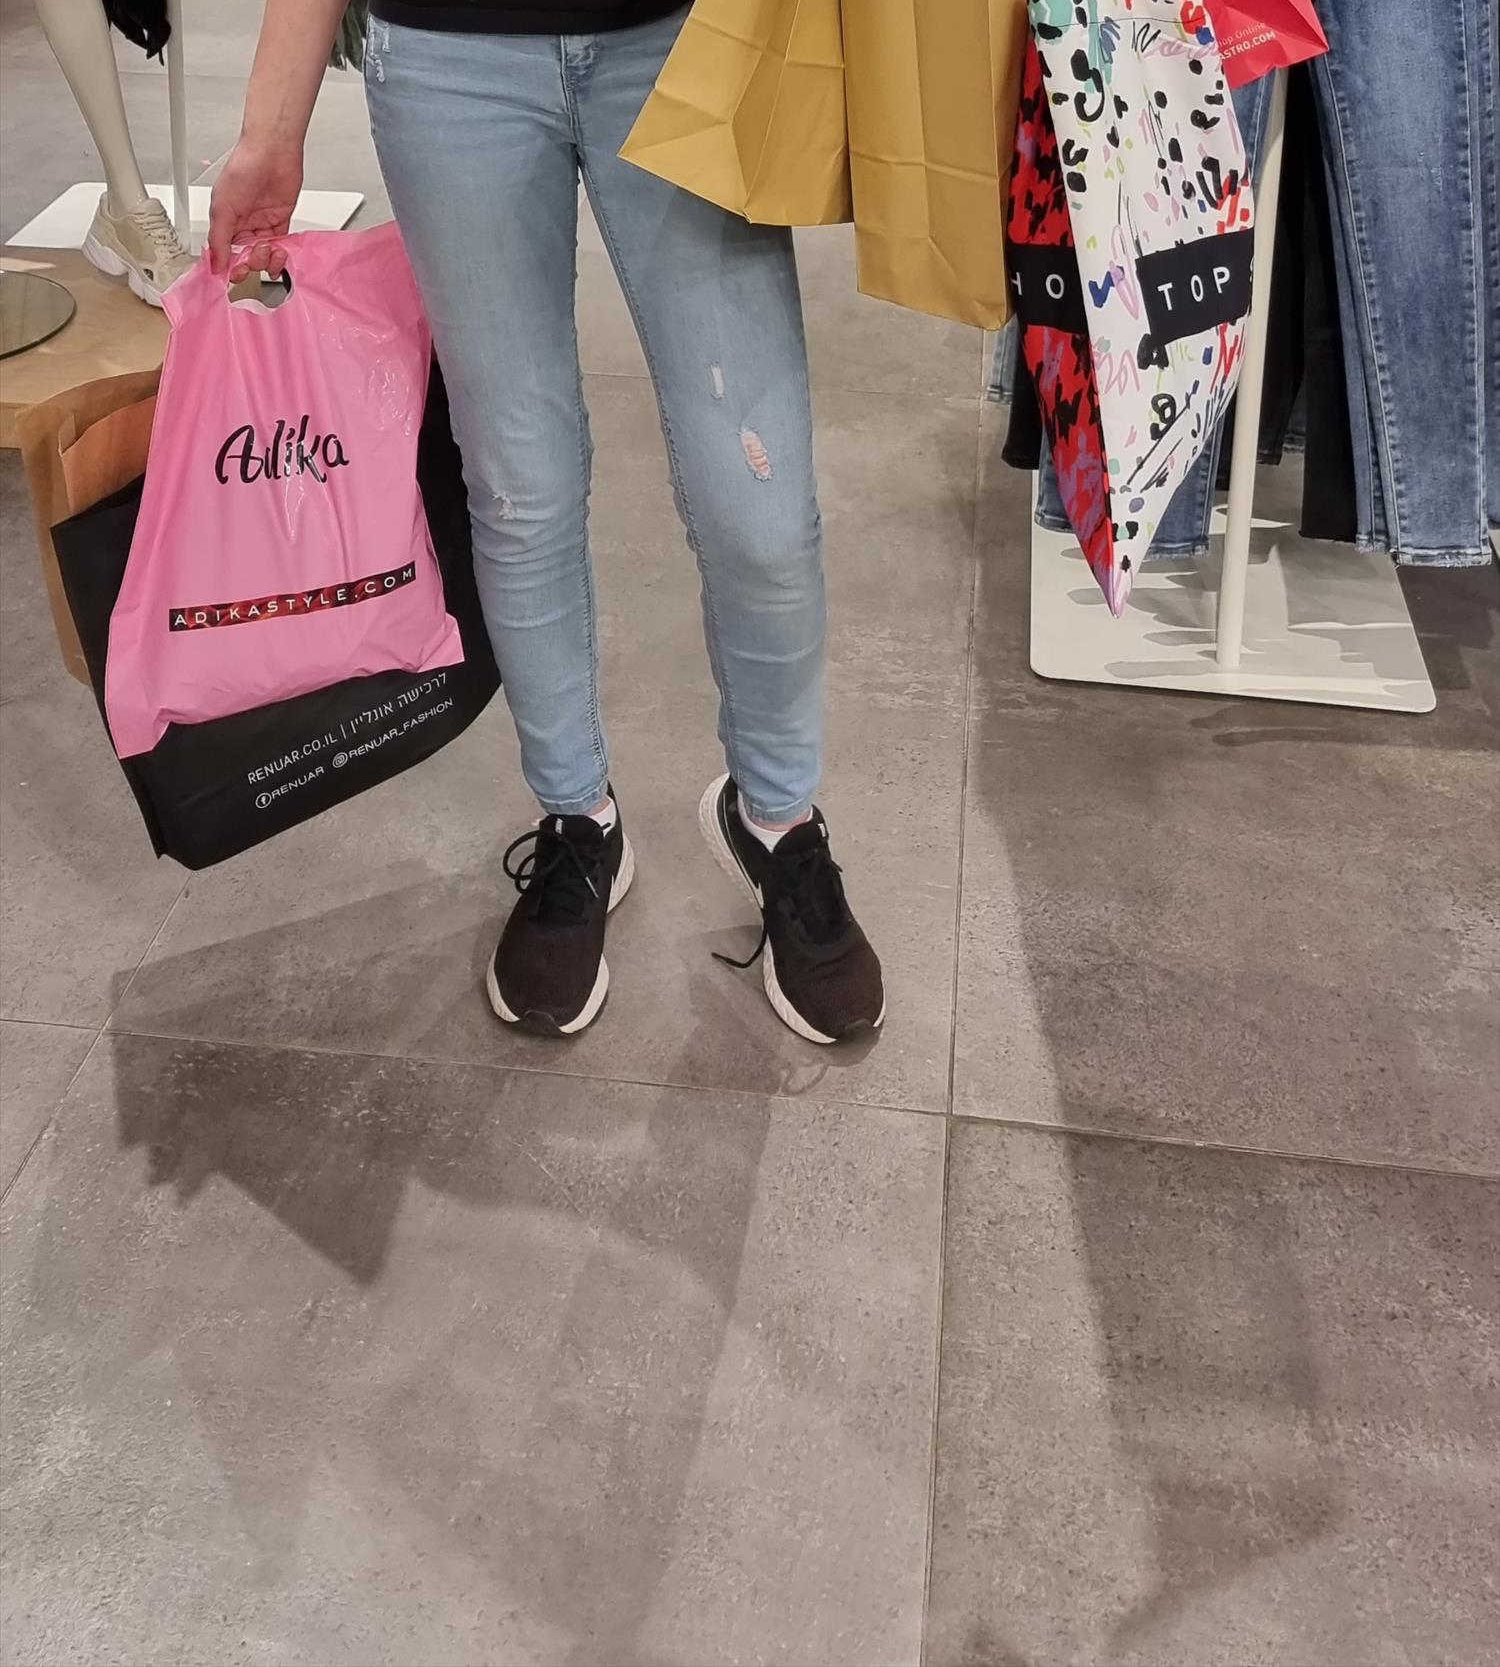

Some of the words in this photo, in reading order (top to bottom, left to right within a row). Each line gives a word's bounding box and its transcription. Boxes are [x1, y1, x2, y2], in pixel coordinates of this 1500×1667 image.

[1219, 30, 1276, 60] ASTRO.COM
[1157, 258, 1254, 311] TOP
[174, 567, 413, 626] ADIKASTYLE.COM
[397, 672, 447, 708] לרכישה
[350, 701, 394, 734] אונליין
[247, 733, 338, 785] RENUAR.CO.IL
